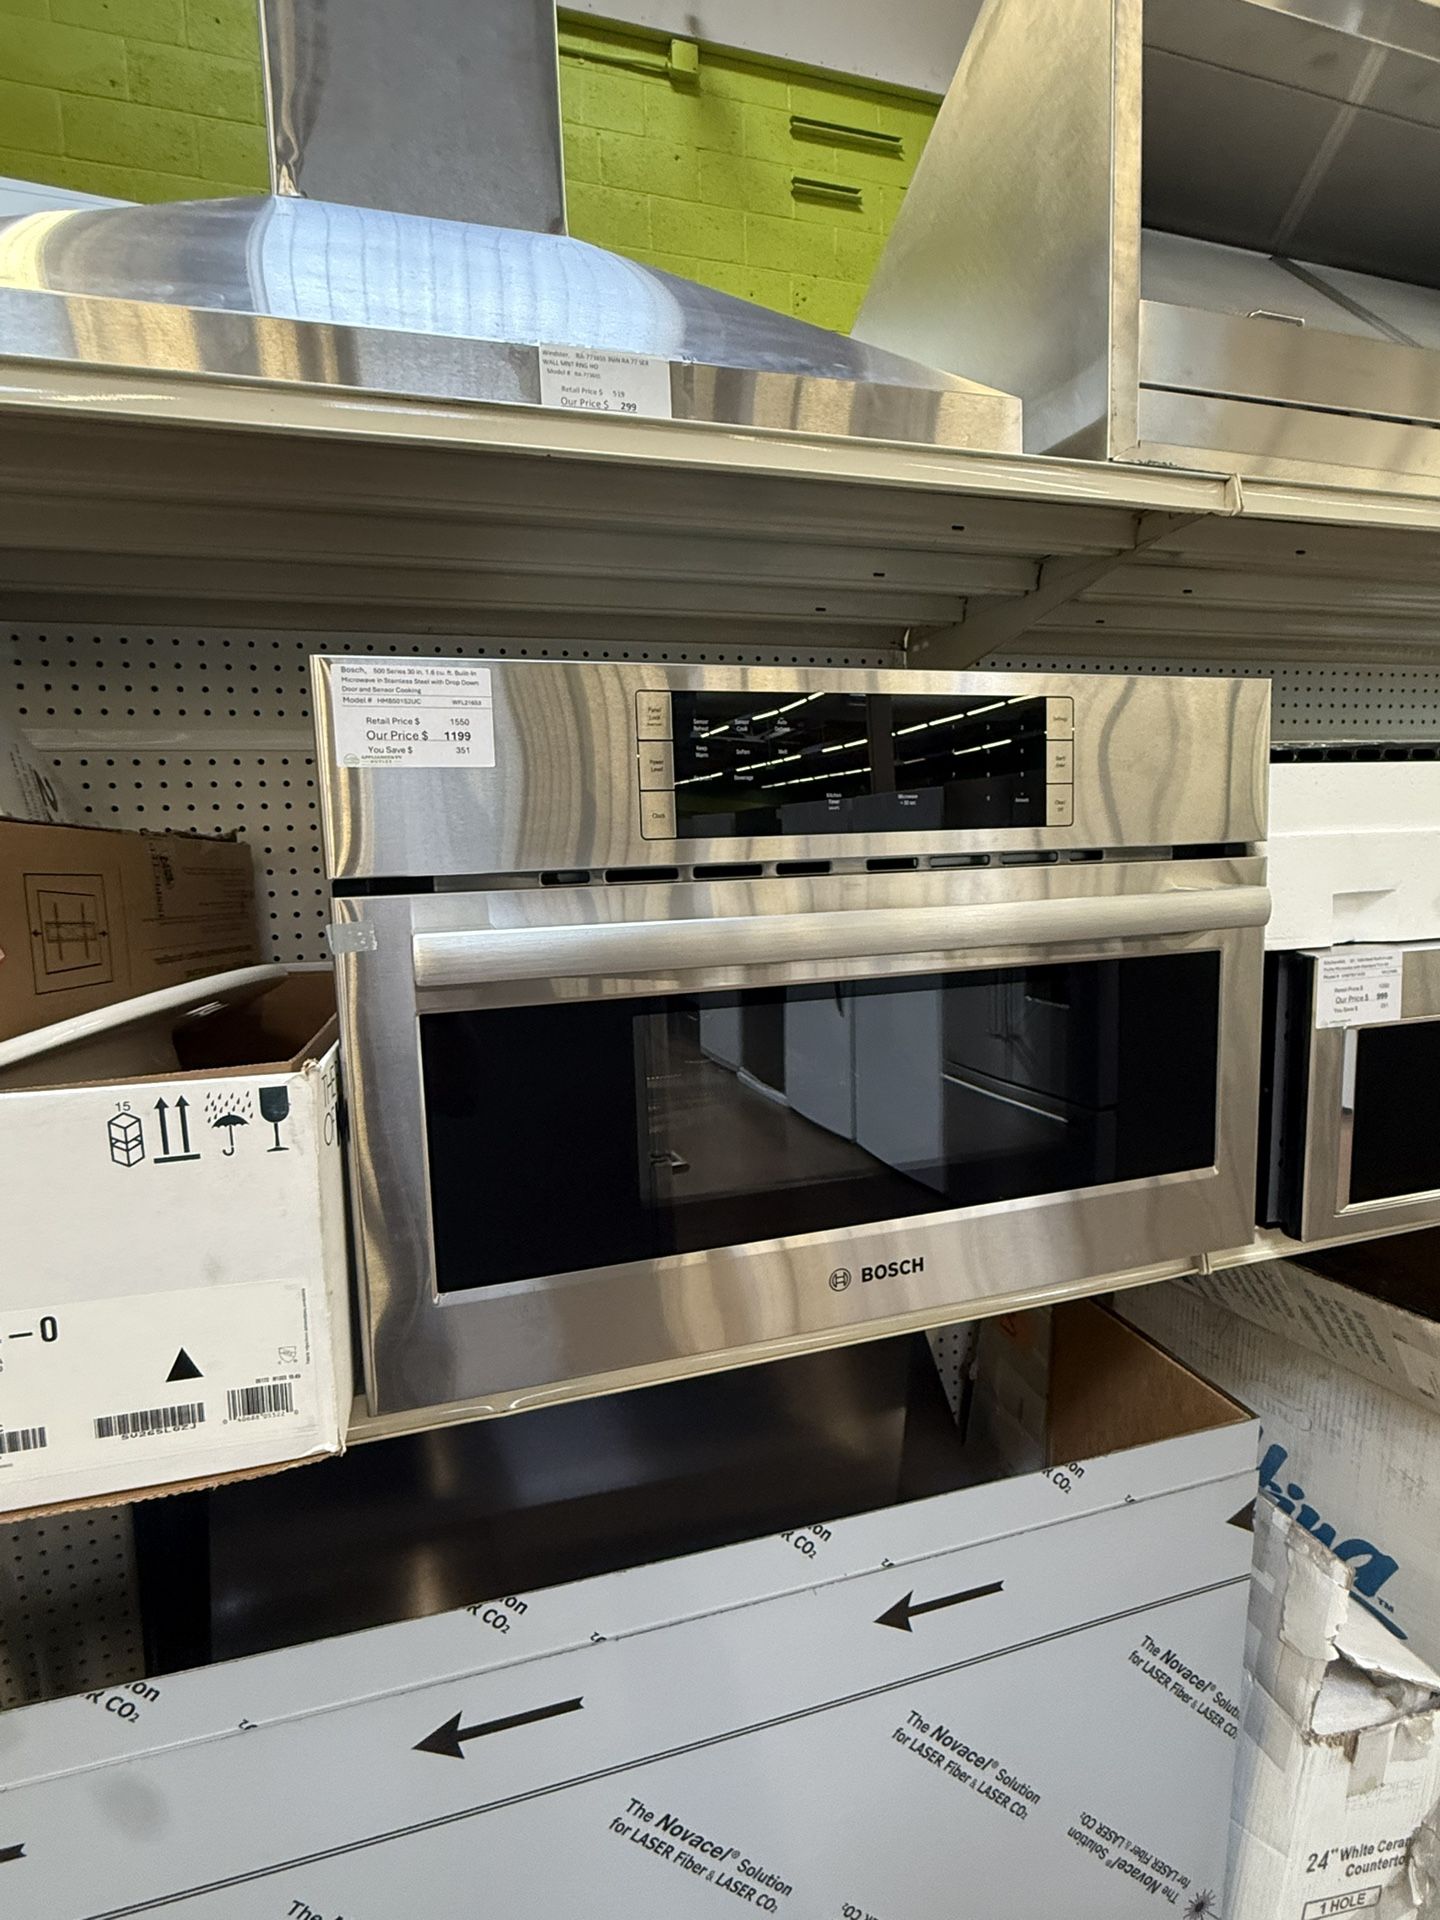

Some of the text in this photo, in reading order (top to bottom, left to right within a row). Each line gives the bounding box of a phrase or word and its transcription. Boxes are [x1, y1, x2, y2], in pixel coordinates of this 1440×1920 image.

[561, 385, 580, 393] Retail
[581, 386, 598, 395] Price
[560, 396, 637, 412] Our Price $ 299
[340, 666, 367, 674] Bosch,
[343, 696, 366, 704] Model
[396, 687, 422, 695] Cooking
[366, 716, 470, 726] Retail Price $ 1550
[366, 730, 471, 741] Our Price $ 1199
[368, 746, 470, 754] You Save $ 351
[1336, 996, 1347, 1004] Our
[115, 1100, 131, 1112] 15
[861, 1257, 924, 1283] BOSCH
[1140, 1634, 1161, 1657] The
[1128, 1650, 1144, 1667] for
[1141, 1660, 1172, 1689] LASER
[1169, 1681, 1193, 1704] Fiber
[1191, 1700, 1198, 1709] &
[1196, 1702, 1225, 1728] LASER
[906, 1710, 930, 1734] The
[995, 1768, 1041, 1805] Solution
[892, 1727, 911, 1745] for
[908, 1738, 946, 1768] LASER
[944, 1760, 972, 1784] Fiber
[970, 1778, 977, 1789] &
[976, 1781, 1012, 1809] LASER
[1067, 1826, 1110, 1861] Solution
[1096, 1822, 1126, 1847] LASER
[624, 1797, 654, 1823] The
[736, 1858, 793, 1896] Solution
[1125, 1842, 1131, 1850] &
[1130, 1844, 1152, 1866] Fiber
[1340, 1844, 1374, 1862] White
[608, 1816, 632, 1837] for
[630, 1828, 674, 1860] LASER
[672, 1851, 708, 1877] Fiber
[705, 1870, 714, 1882] &
[714, 1872, 757, 1902] LASER
[1151, 1856, 1180, 1882] LASER
[1178, 1874, 1192, 1890] for
[1162, 1884, 1180, 1904] The
[1320, 1892, 1366, 1914] 1 HOLE
